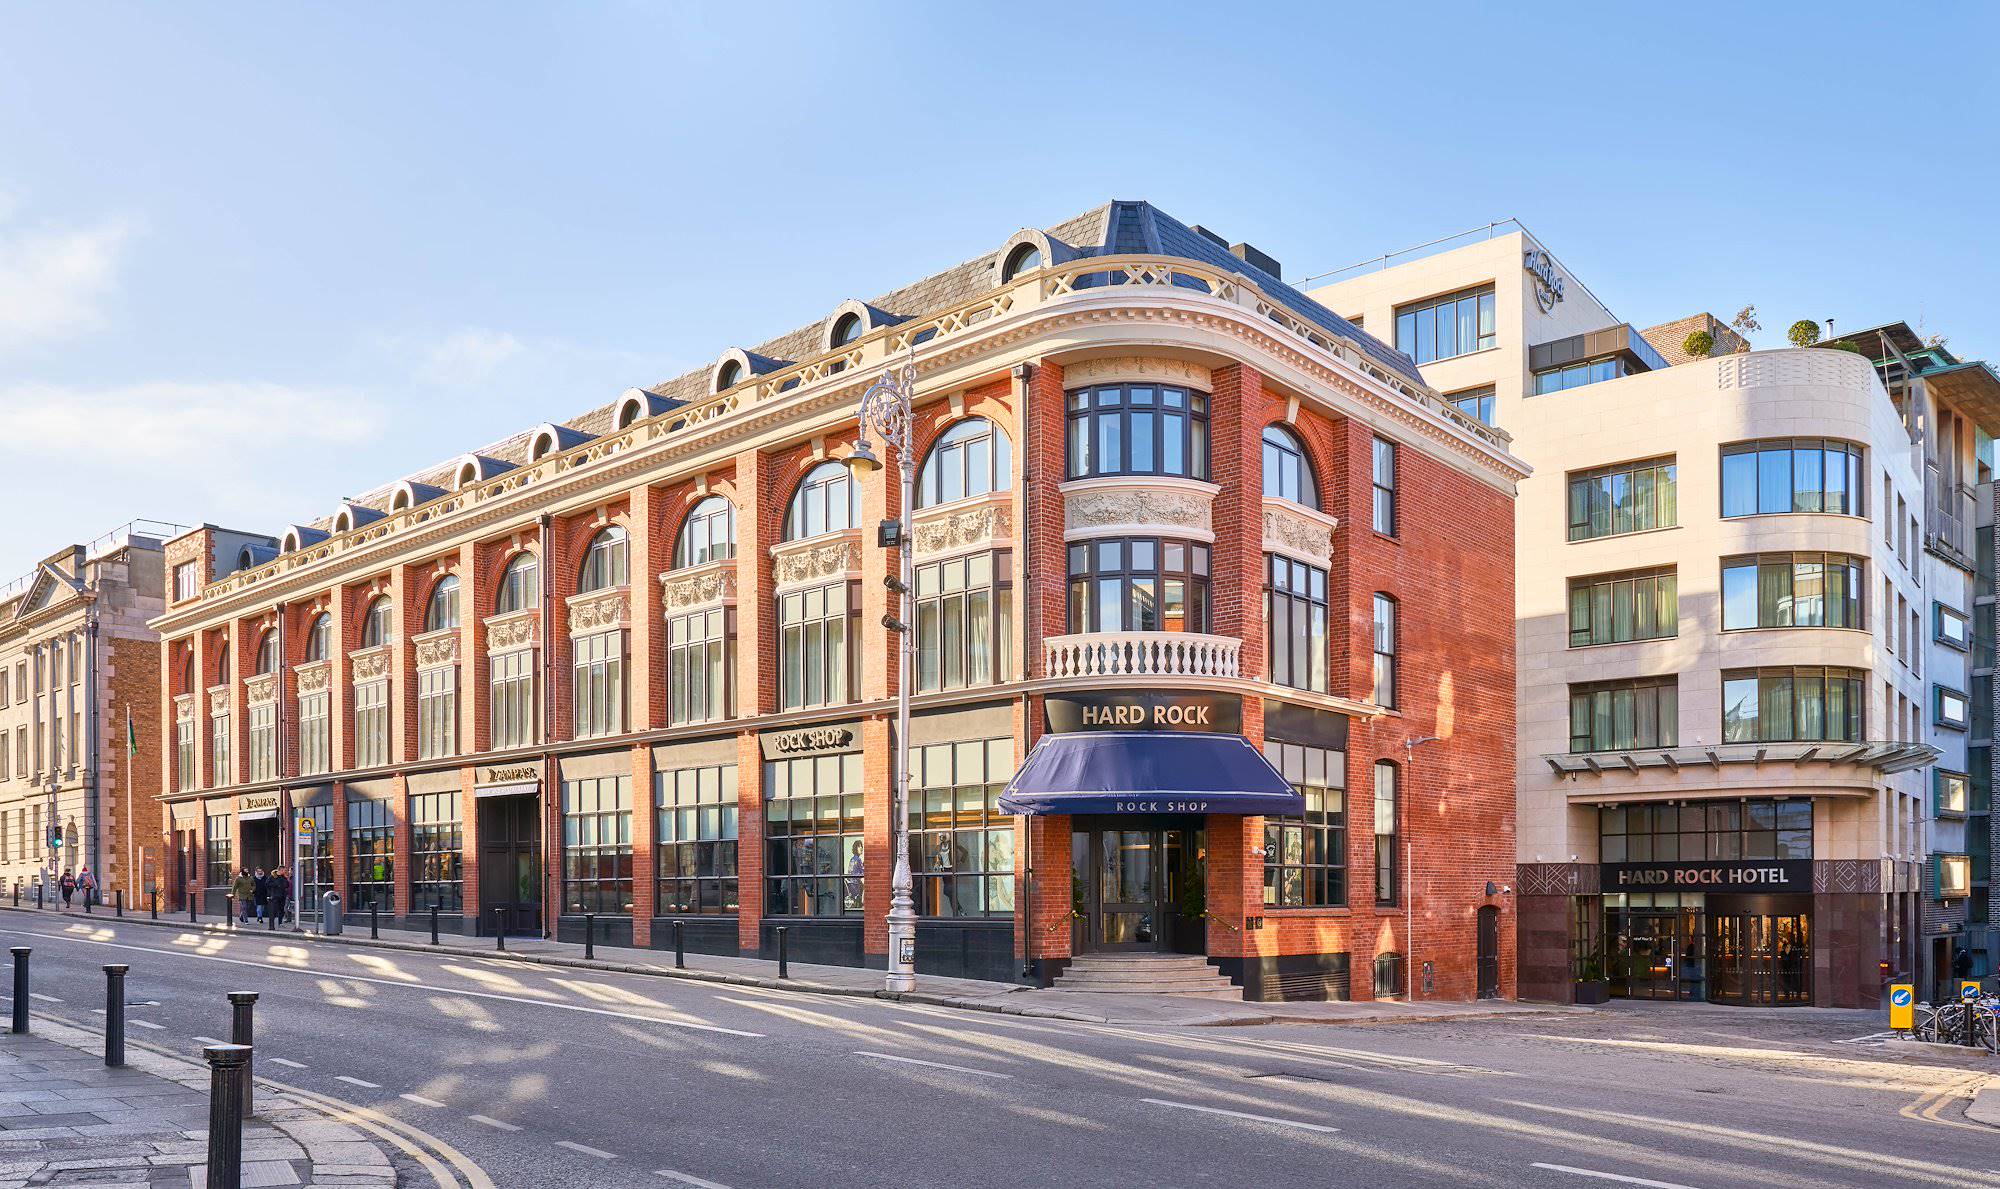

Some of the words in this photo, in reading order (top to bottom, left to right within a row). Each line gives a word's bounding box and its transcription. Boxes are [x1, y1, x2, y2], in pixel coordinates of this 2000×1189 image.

[1082, 705, 1145, 725] HARD
[1153, 705, 1209, 725] ROCK
[774, 732, 807, 751] ROCK
[809, 728, 845, 748] SHOP
[1116, 802, 1158, 811] ROCK
[1167, 802, 1208, 811] SHOP
[1618, 869, 1668, 885] HARD
[1674, 869, 1723, 884] ROCK
[1729, 868, 1789, 884] HOTEL
